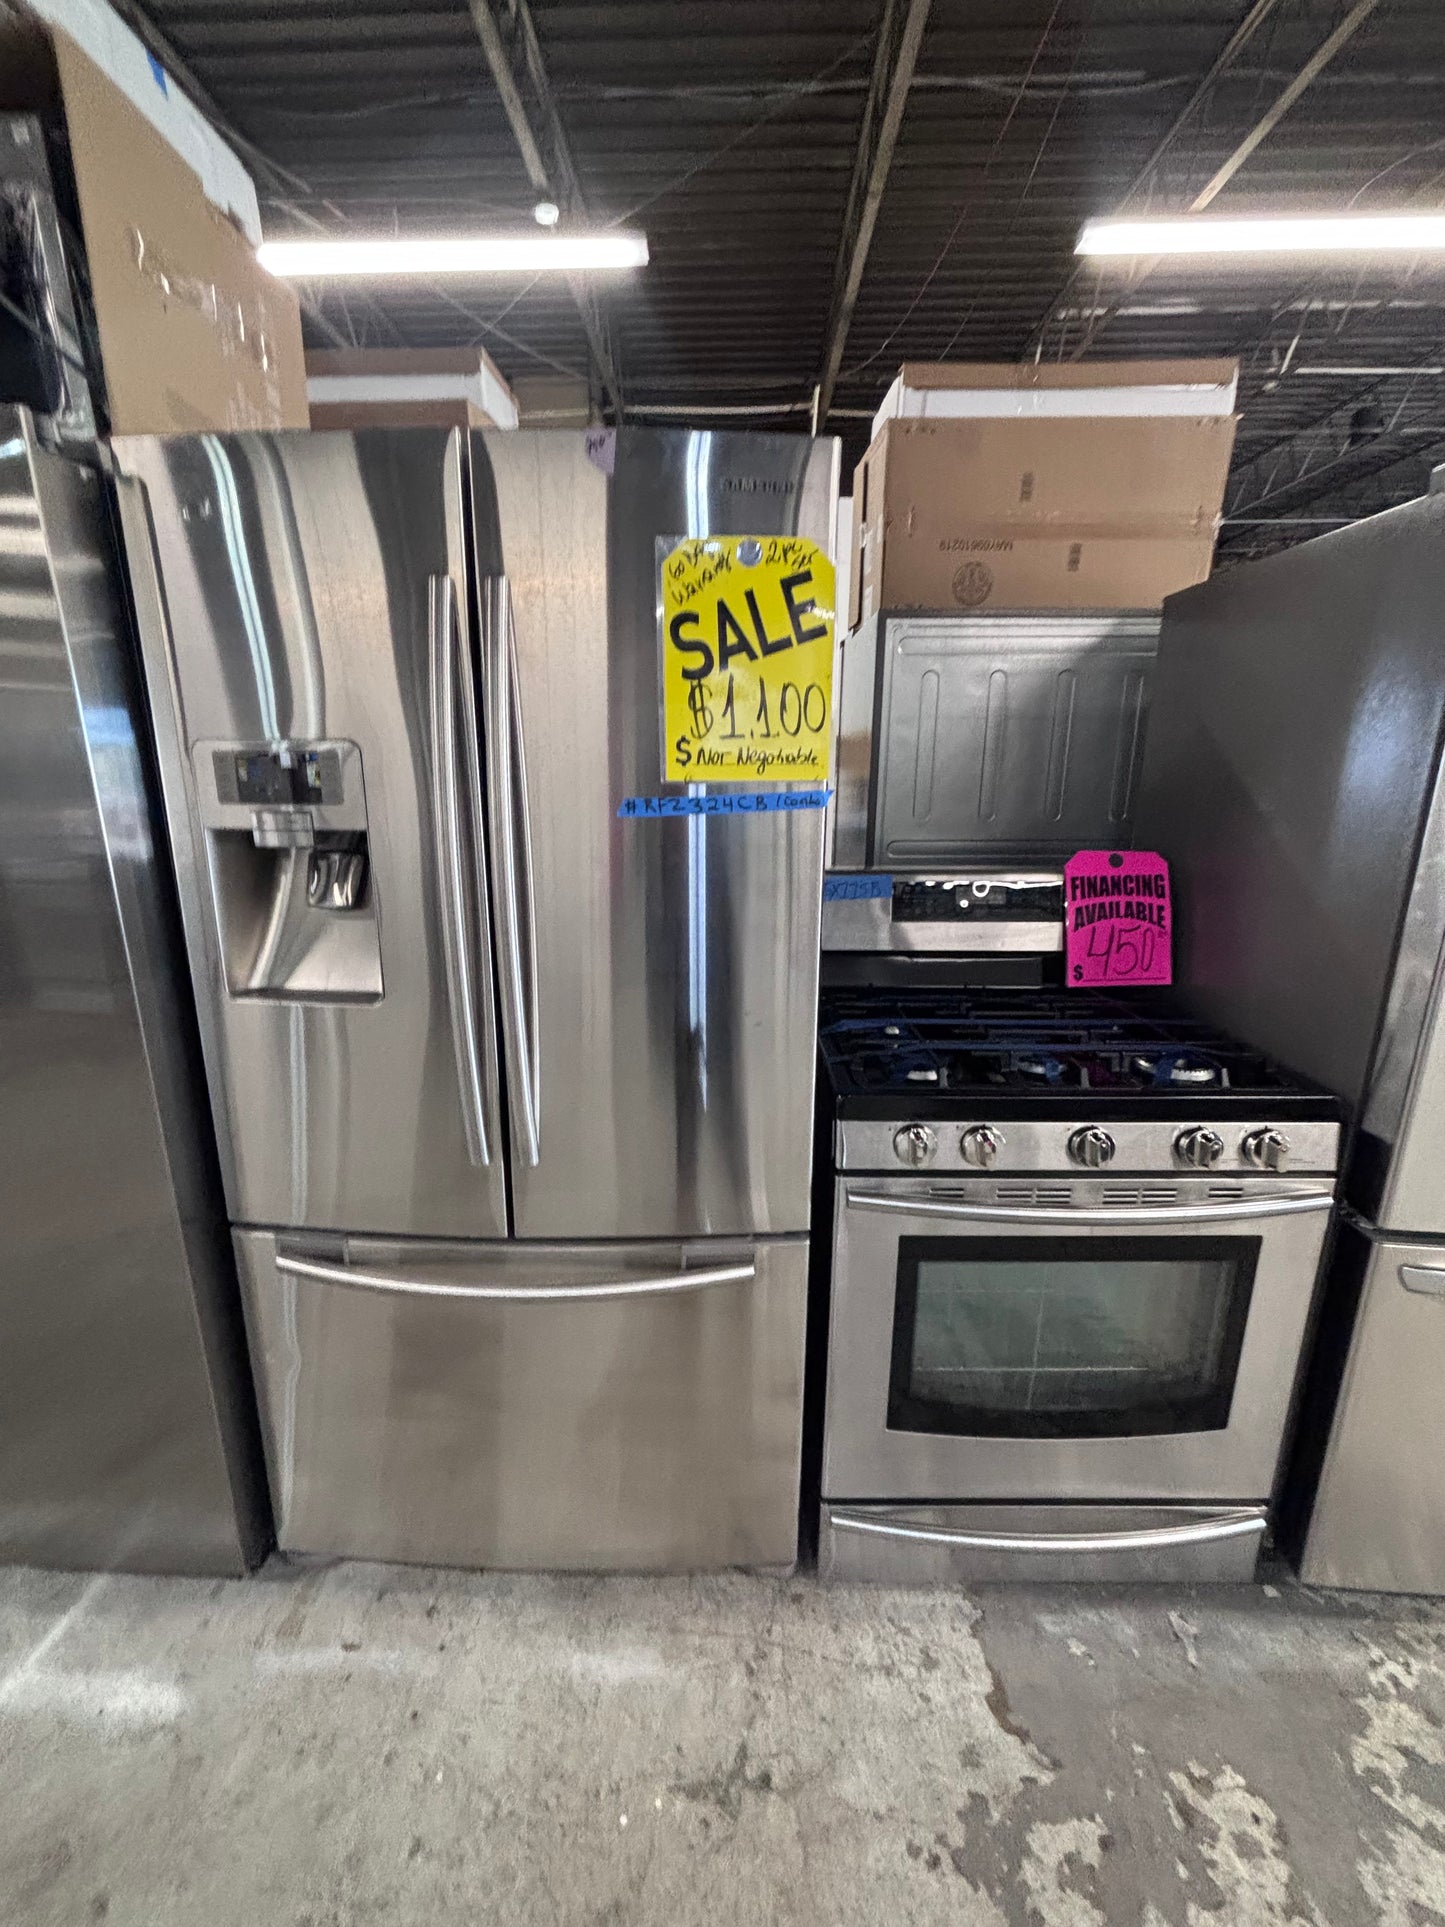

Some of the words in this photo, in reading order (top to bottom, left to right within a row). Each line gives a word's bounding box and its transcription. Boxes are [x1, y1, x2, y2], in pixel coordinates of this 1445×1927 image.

[670, 570, 828, 680] SALE
[1070, 873, 1166, 901] FINANCING
[1073, 901, 1166, 933] AVAILABLE
[1073, 964, 1083, 982] $
[1087, 925, 1155, 976] 450
